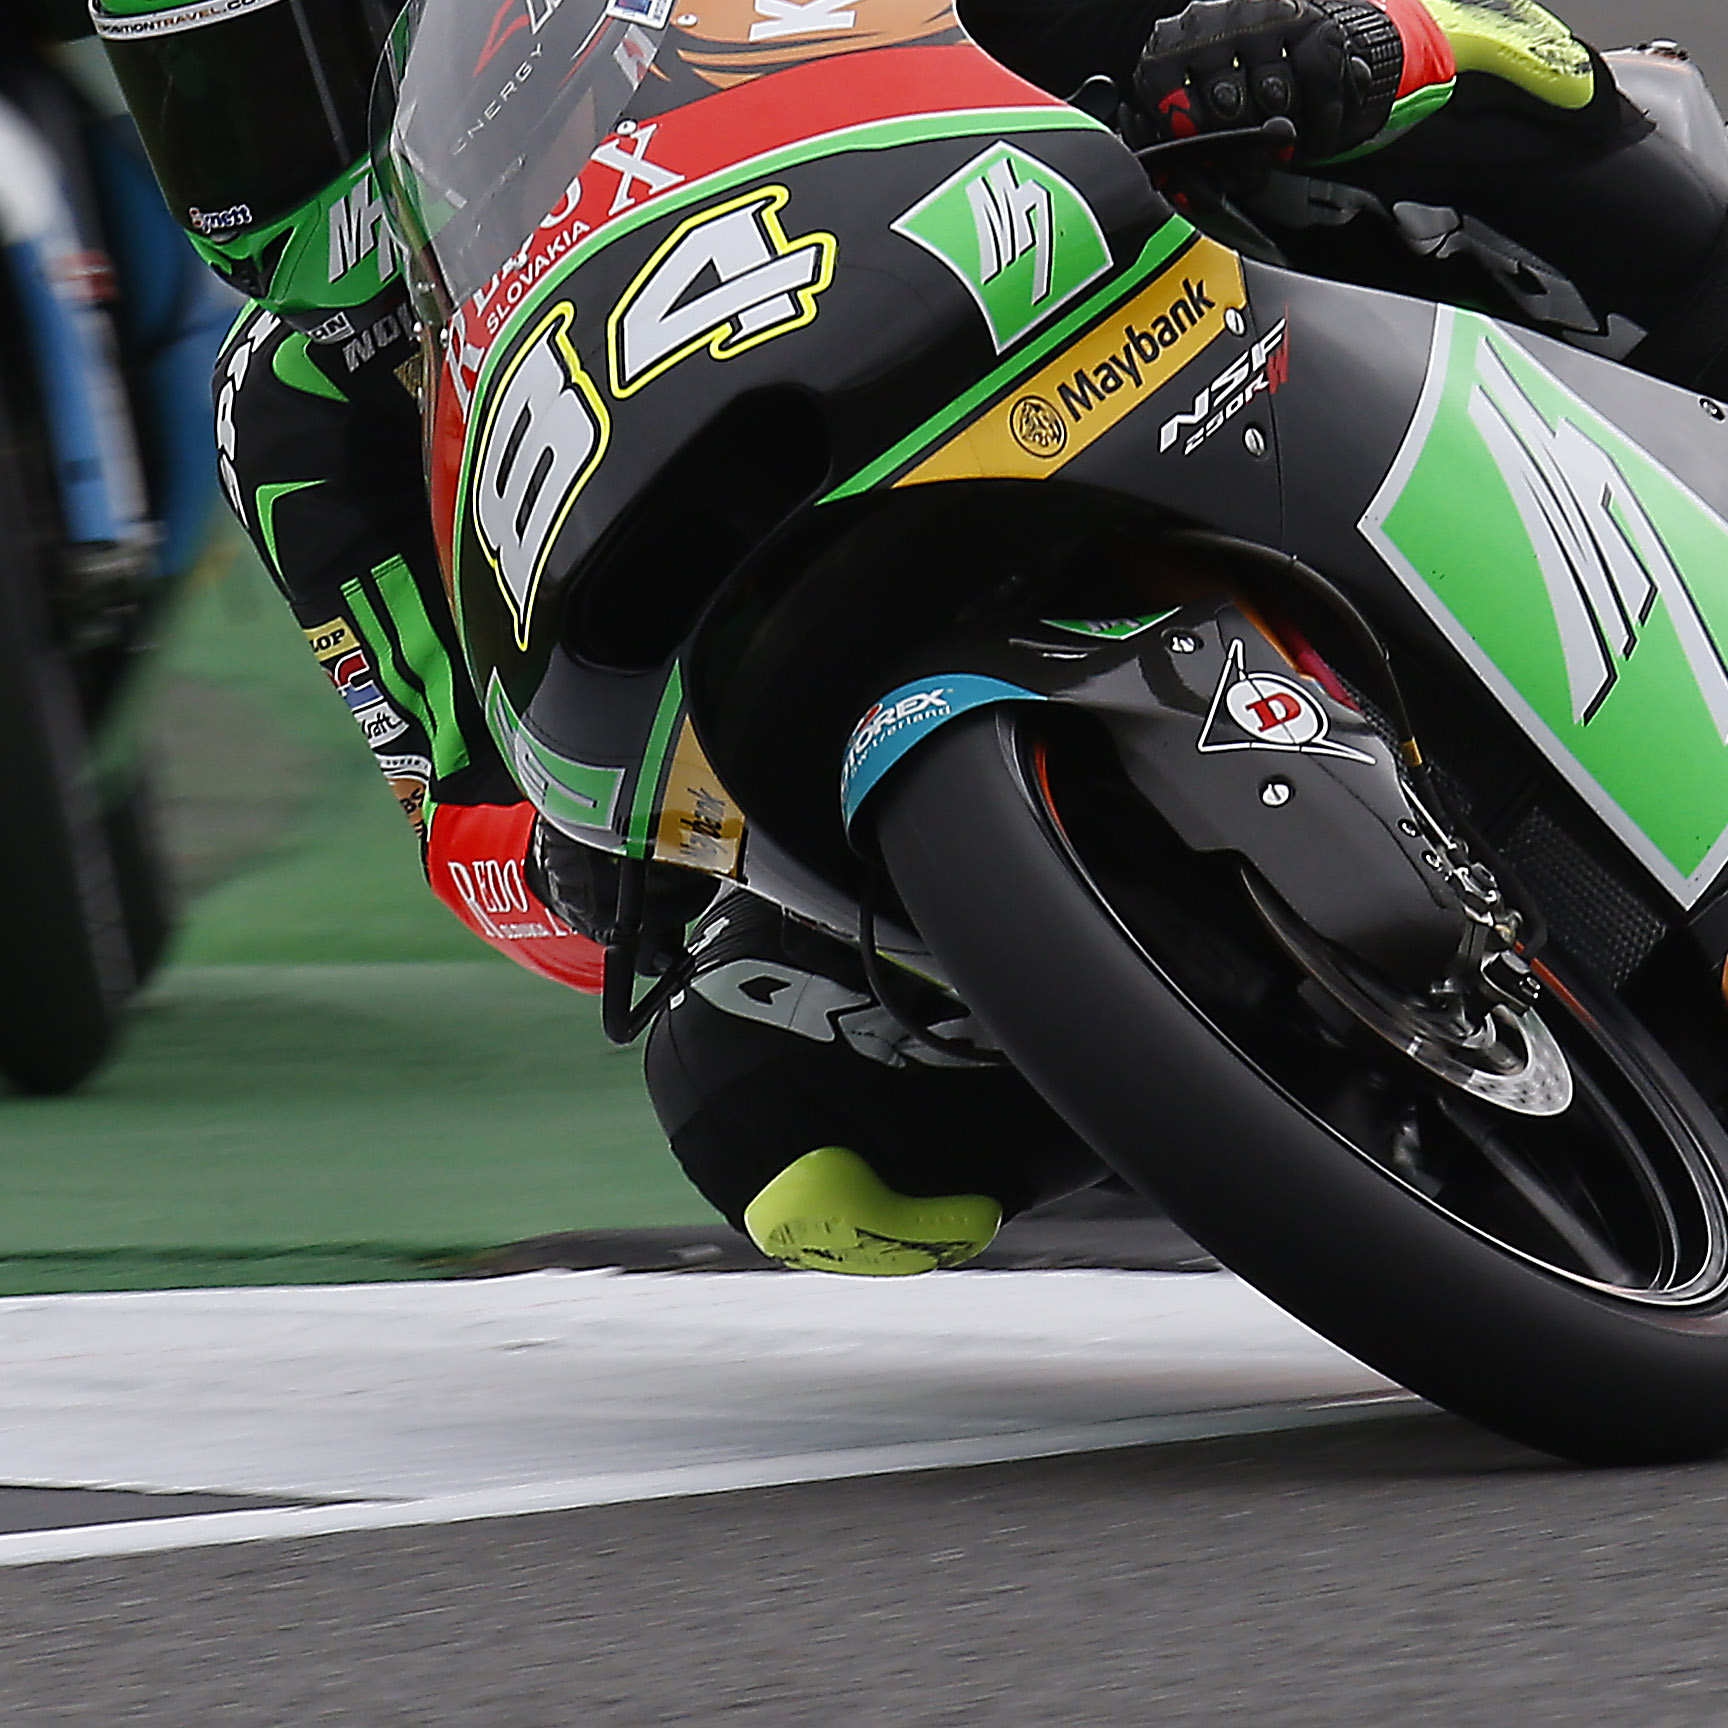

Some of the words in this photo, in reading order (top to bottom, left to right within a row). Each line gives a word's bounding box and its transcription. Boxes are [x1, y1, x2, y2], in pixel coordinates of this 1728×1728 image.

[485, 220, 591, 335] SLOVAKIA
[1056, 276, 1216, 423] Maybank
[1157, 317, 1287, 454] NSF
[1183, 372, 1272, 456] 250R
